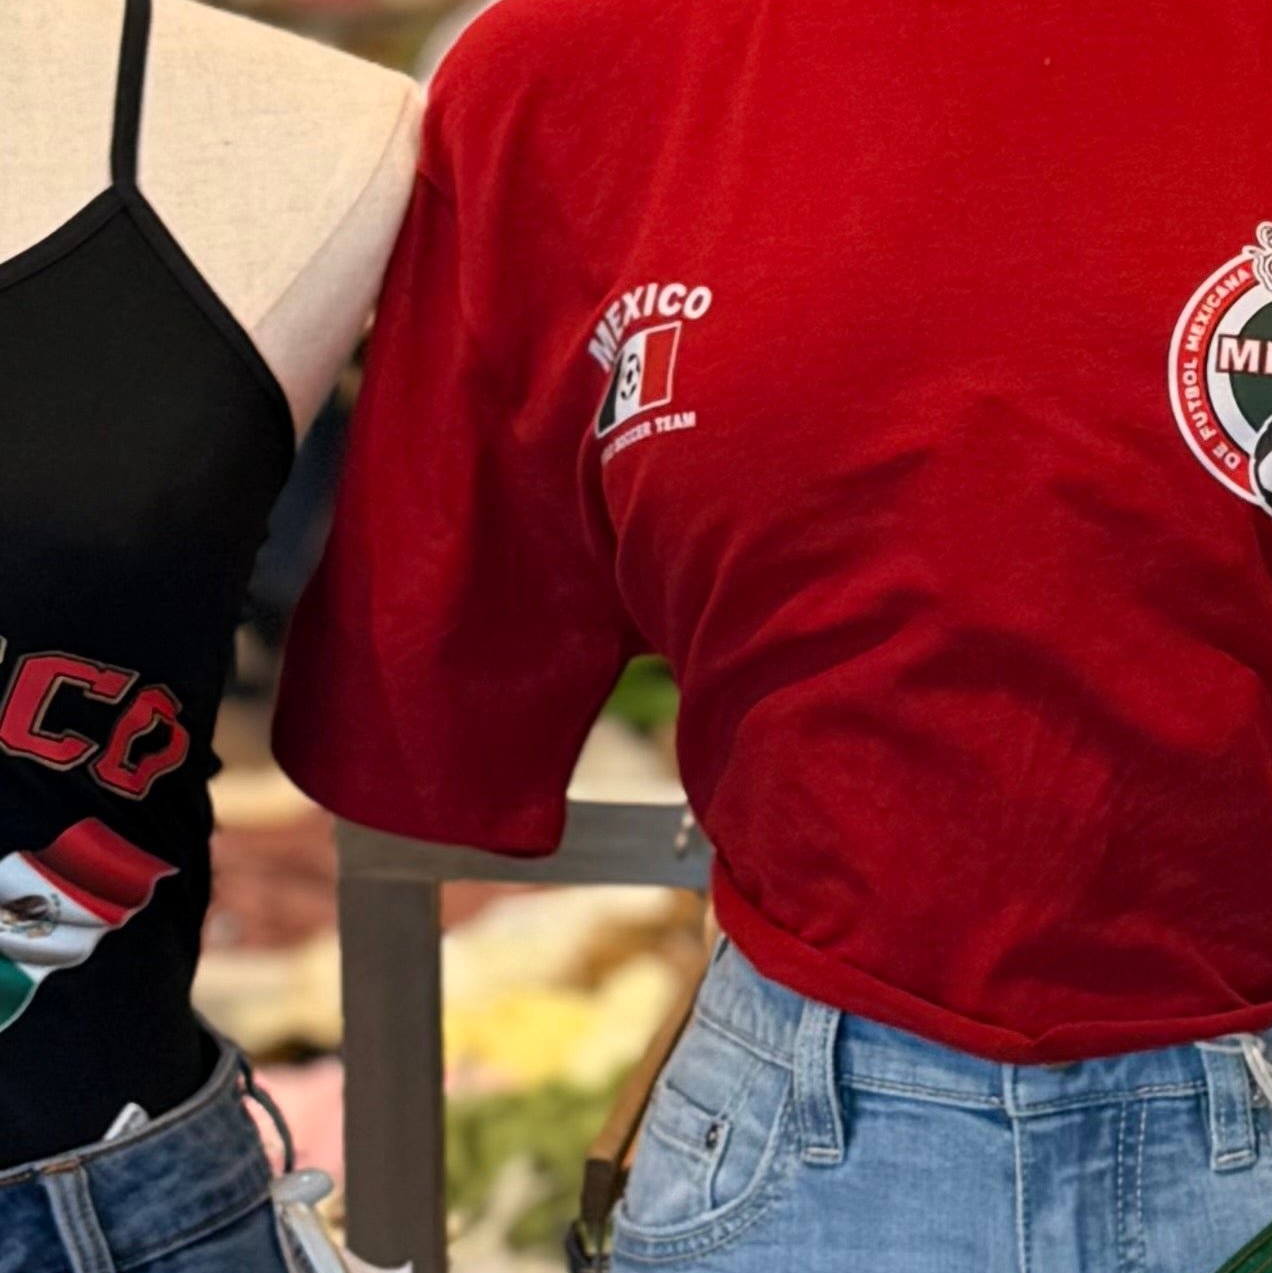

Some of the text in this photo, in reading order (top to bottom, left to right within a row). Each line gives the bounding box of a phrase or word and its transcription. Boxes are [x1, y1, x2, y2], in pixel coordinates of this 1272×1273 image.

[588, 282, 713, 374] MEXICO
[1182, 267, 1252, 471] DE FUTBOL MEXICANA
[654, 410, 697, 434] TEAM
[0, 635, 190, 801] CO
